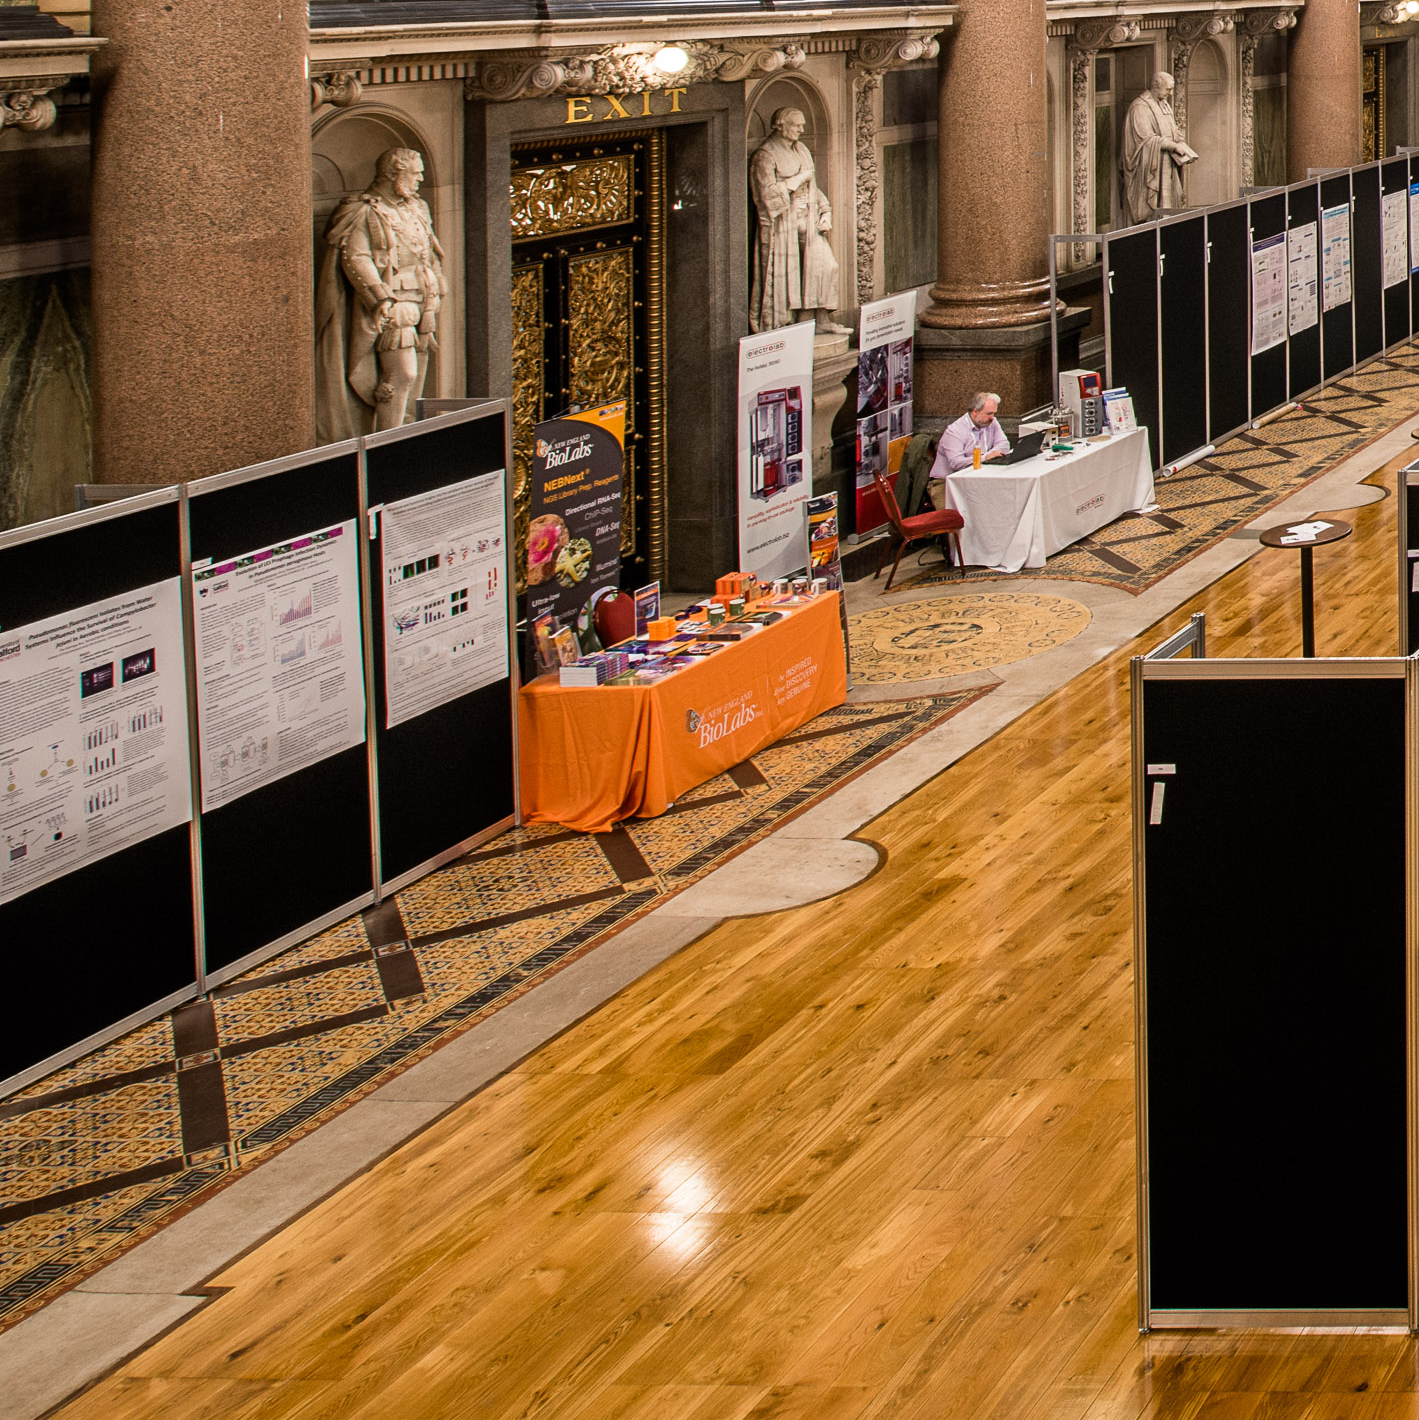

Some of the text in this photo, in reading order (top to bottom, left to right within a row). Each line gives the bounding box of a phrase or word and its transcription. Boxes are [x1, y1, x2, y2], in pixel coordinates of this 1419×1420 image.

[564, 87, 687, 124] EXIT
[747, 342, 785, 357] electrolab
[567, 434, 590, 445] ENGLAND
[544, 441, 593, 470] BioLabs
[565, 492, 621, 516] Directional RNA-Seq
[595, 521, 620, 537] DNA-Seq
[25, 637, 50, 651] Systems
[49, 628, 76, 643] Influence
[87, 618, 108, 630] Survival
[116, 601, 157, 621] Campylobacter
[0, 644, 20, 657] alford
[708, 690, 753, 719] NEW ENGLAND
[698, 703, 757, 749] BioLabs
